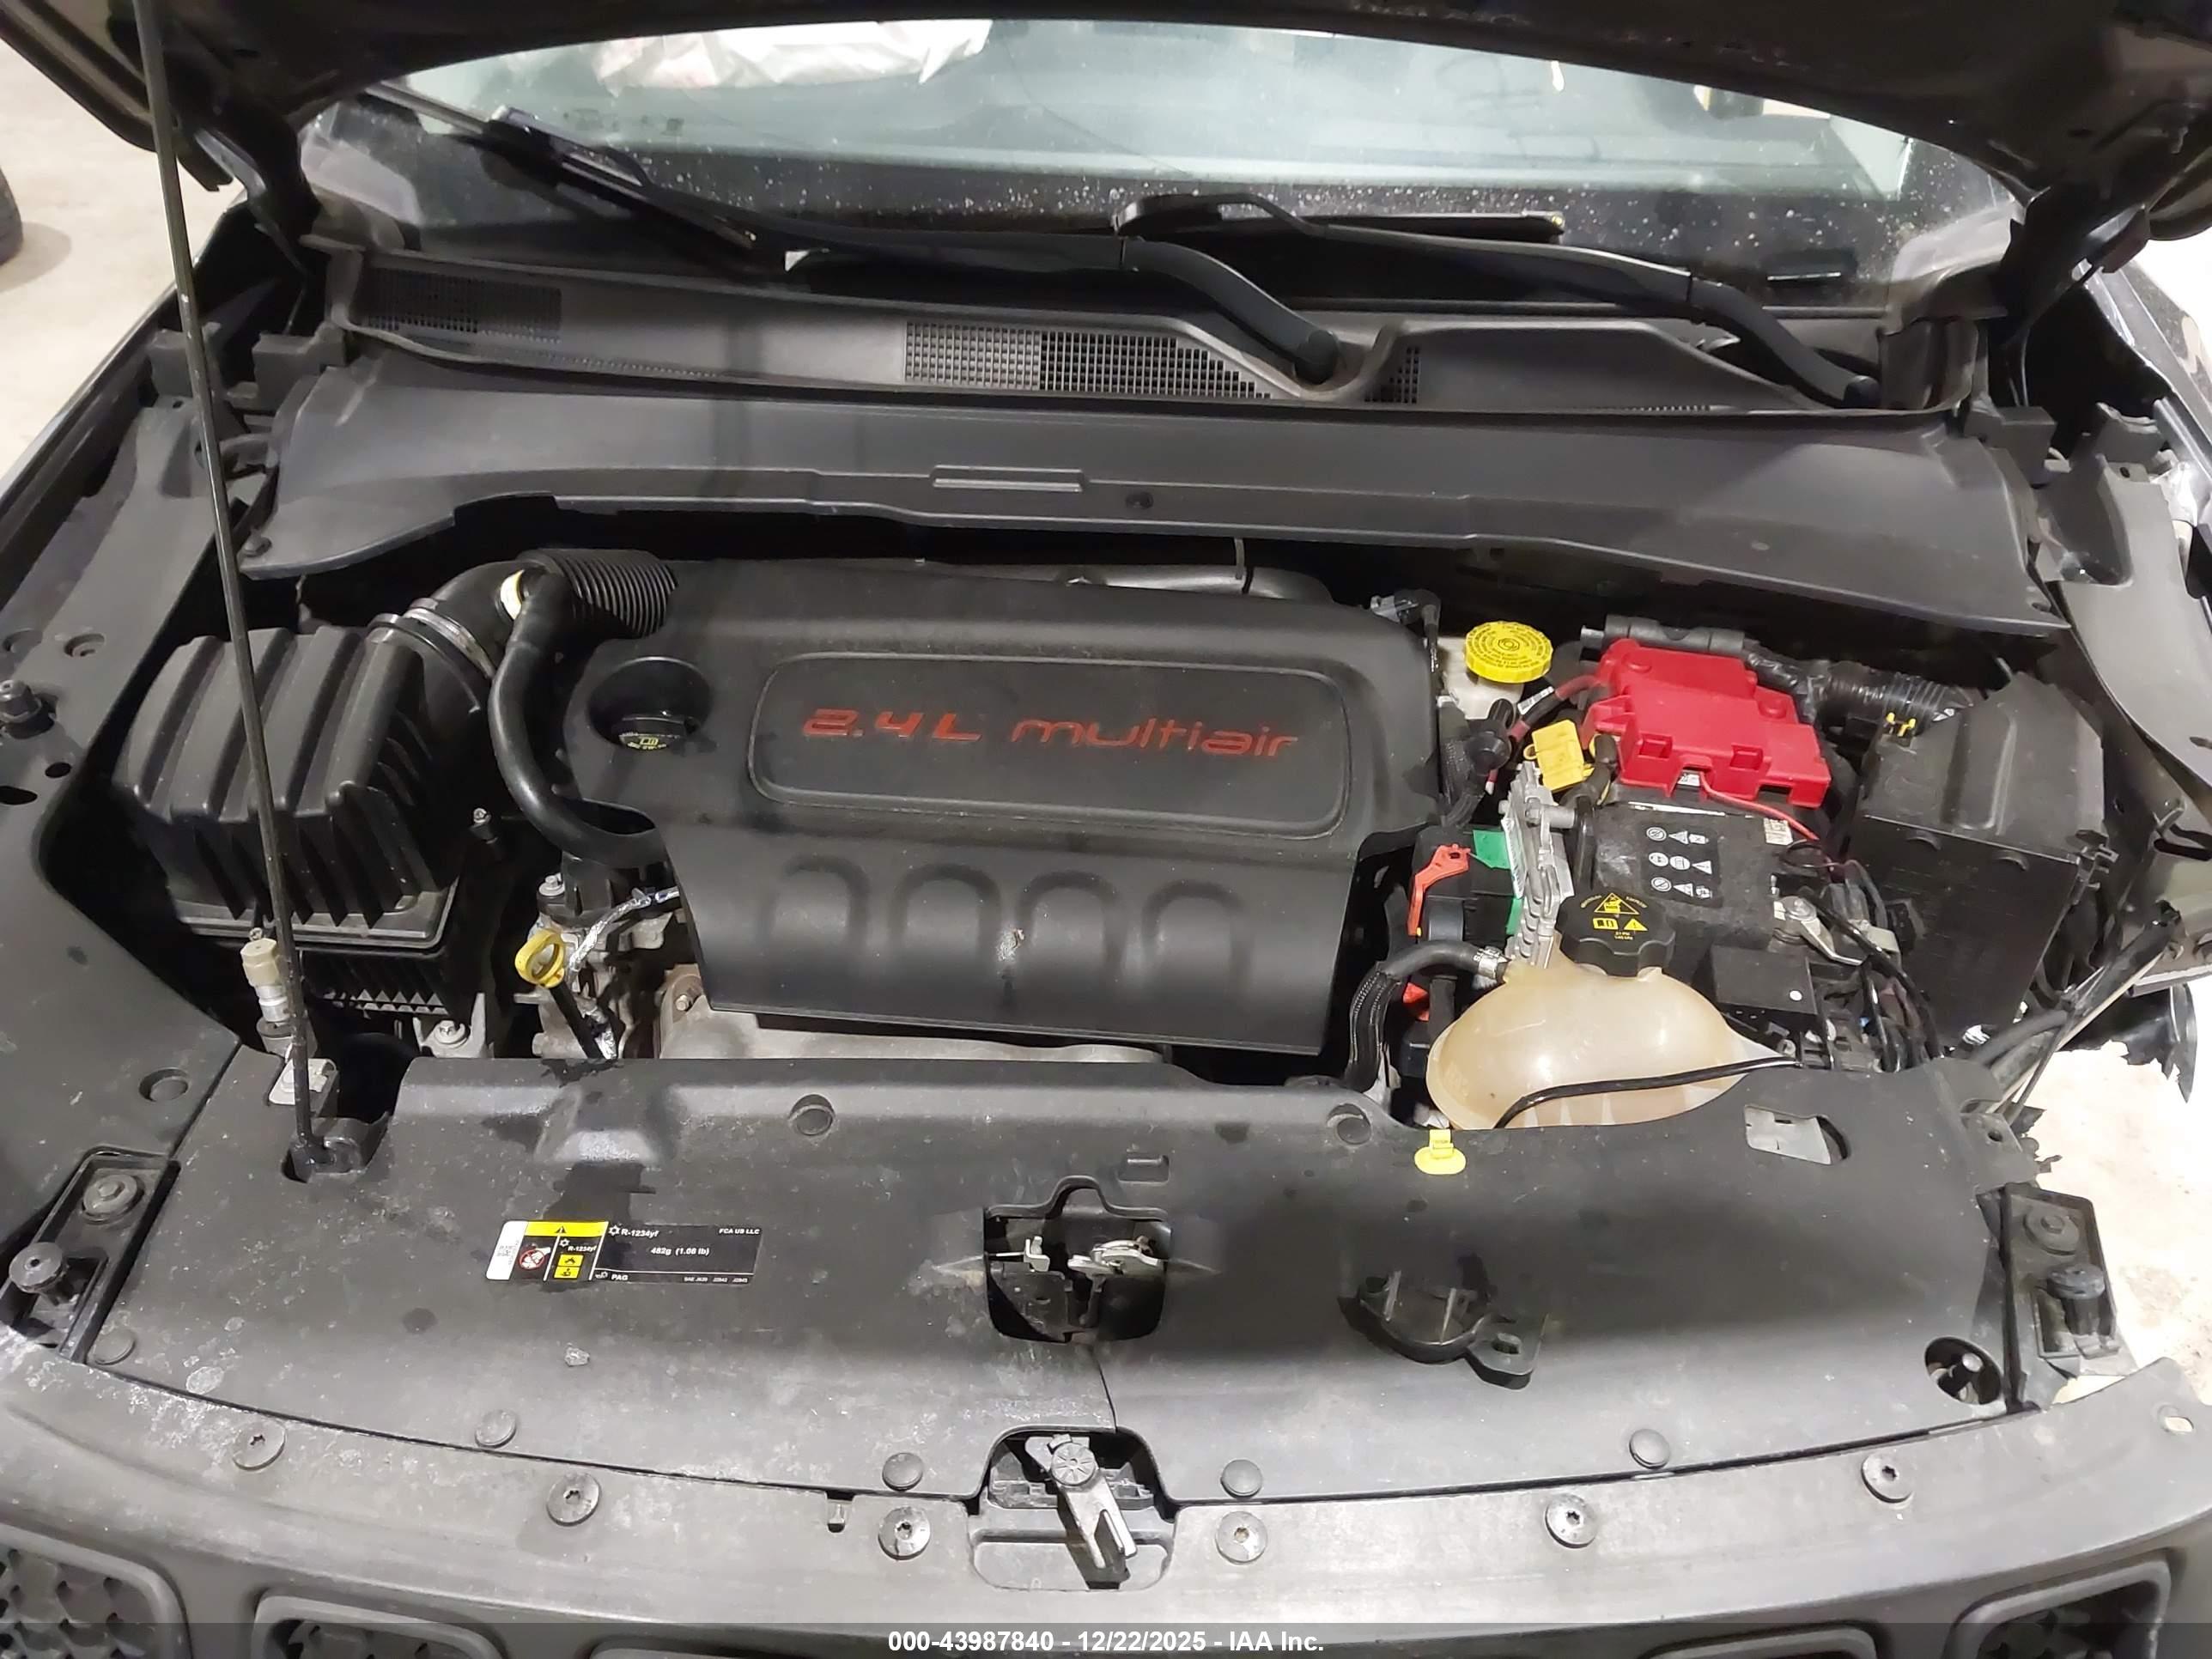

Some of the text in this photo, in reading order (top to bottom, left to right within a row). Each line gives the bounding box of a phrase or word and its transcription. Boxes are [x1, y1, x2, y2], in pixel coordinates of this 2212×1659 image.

[1011, 717, 1299, 759] multiair
[621, 1228, 659, 1238] R-1234yf
[650, 1247, 672, 1256] 482g
